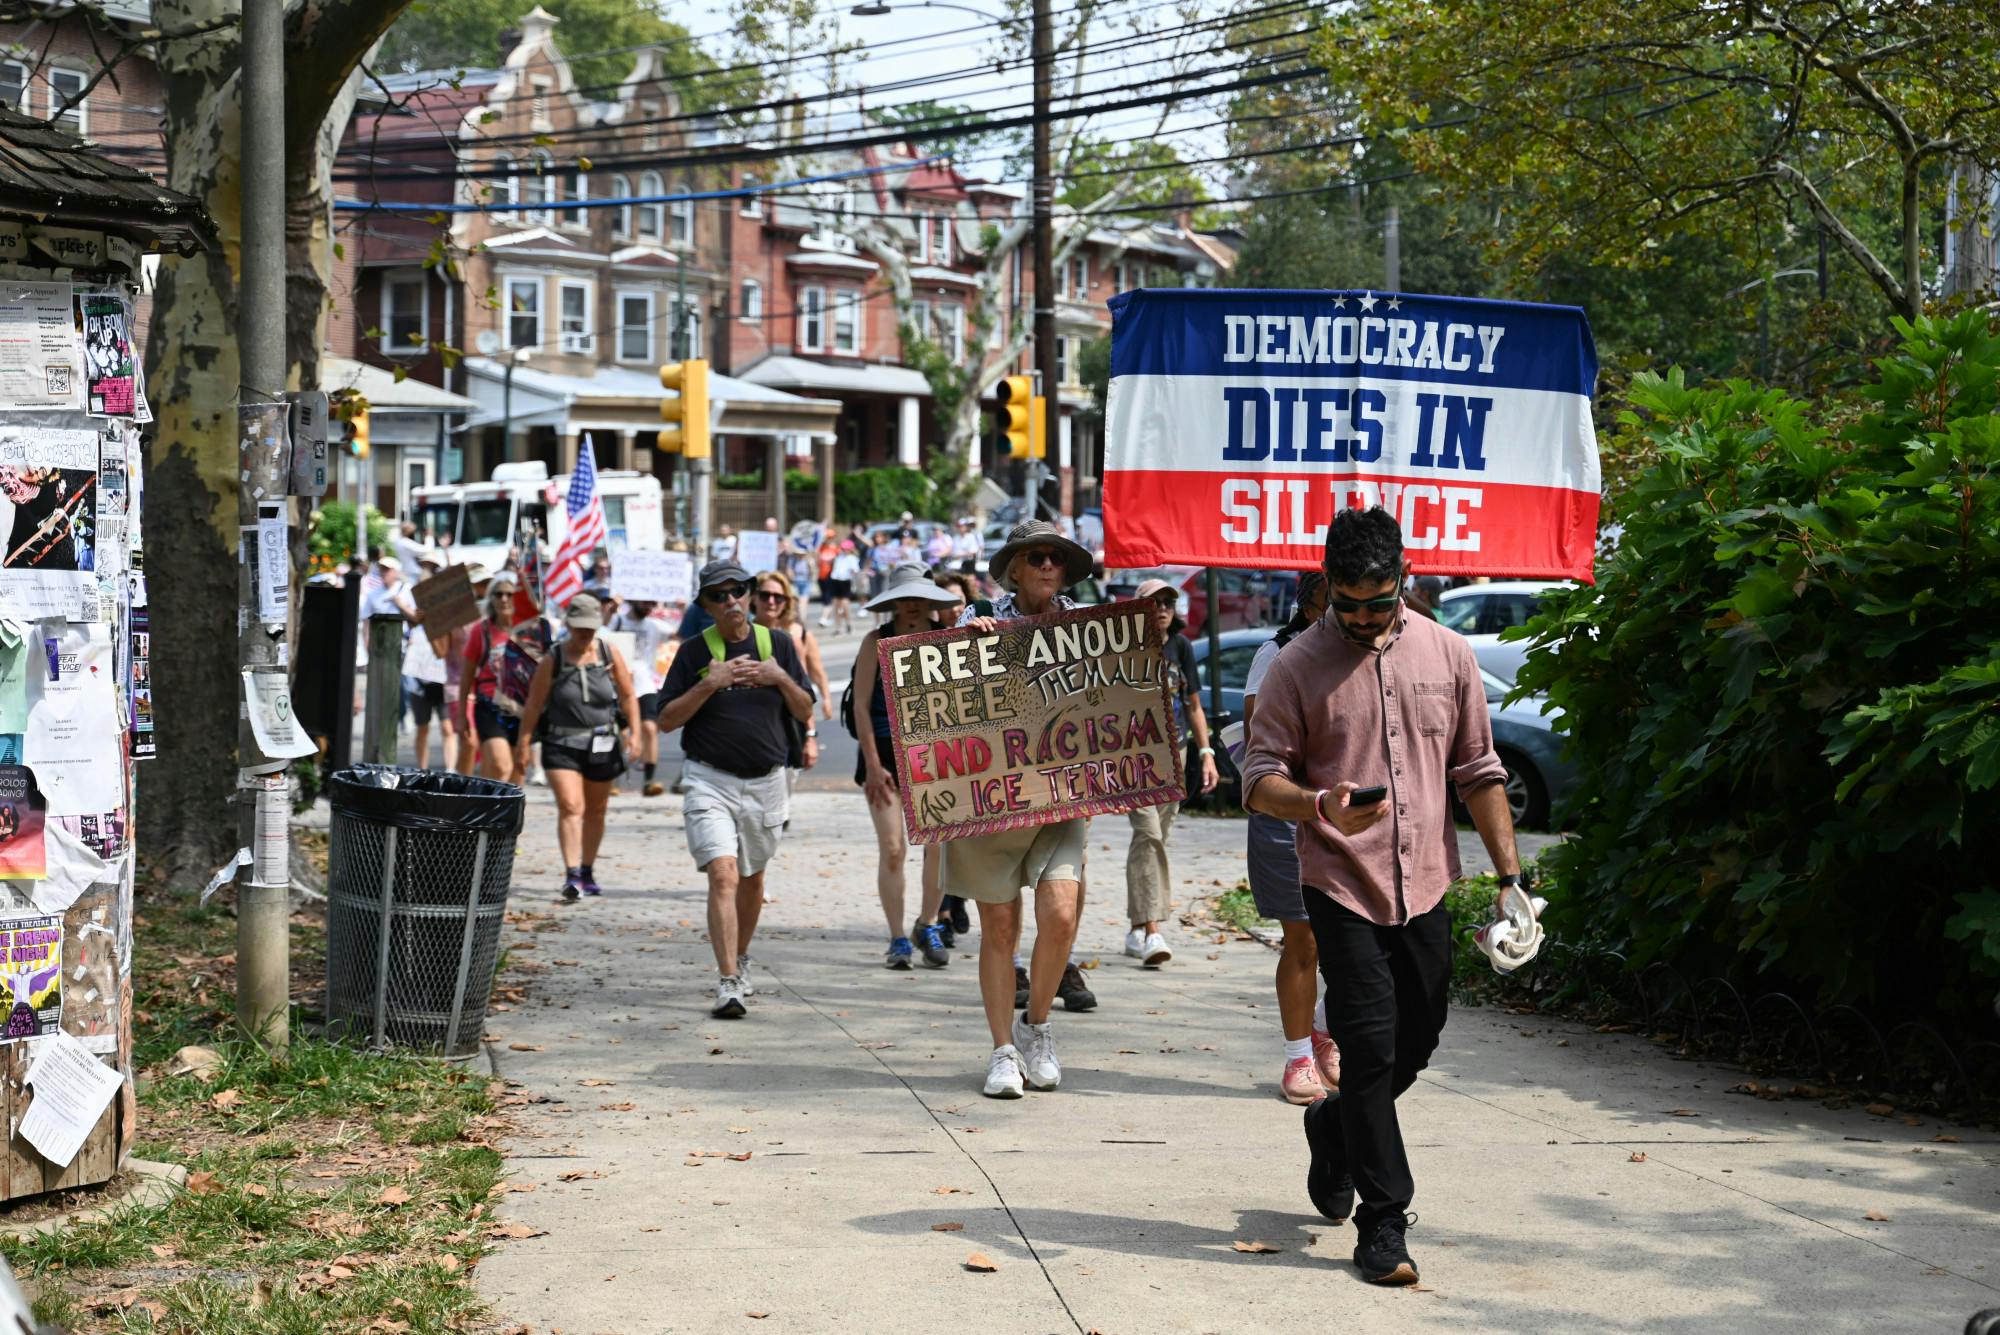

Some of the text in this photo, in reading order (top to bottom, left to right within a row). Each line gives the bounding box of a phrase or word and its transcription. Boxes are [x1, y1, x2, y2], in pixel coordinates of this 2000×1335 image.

[1223, 314, 1505, 374] DEMOCRACY
[1222, 387, 1492, 470] DIES IN
[892, 613, 1146, 688] FREE ANOU!
[899, 680, 1017, 734] FREE
[1026, 658, 1110, 706] THEM
[907, 708, 1164, 785] END RACISM
[920, 753, 1166, 826] AND ICE TERROR
[12, 945, 48, 962] NIGH!
[15, 928, 59, 946] DREAM
[21, 920, 49, 928] THEATRE
[11, 1014, 32, 1026] CAVE
